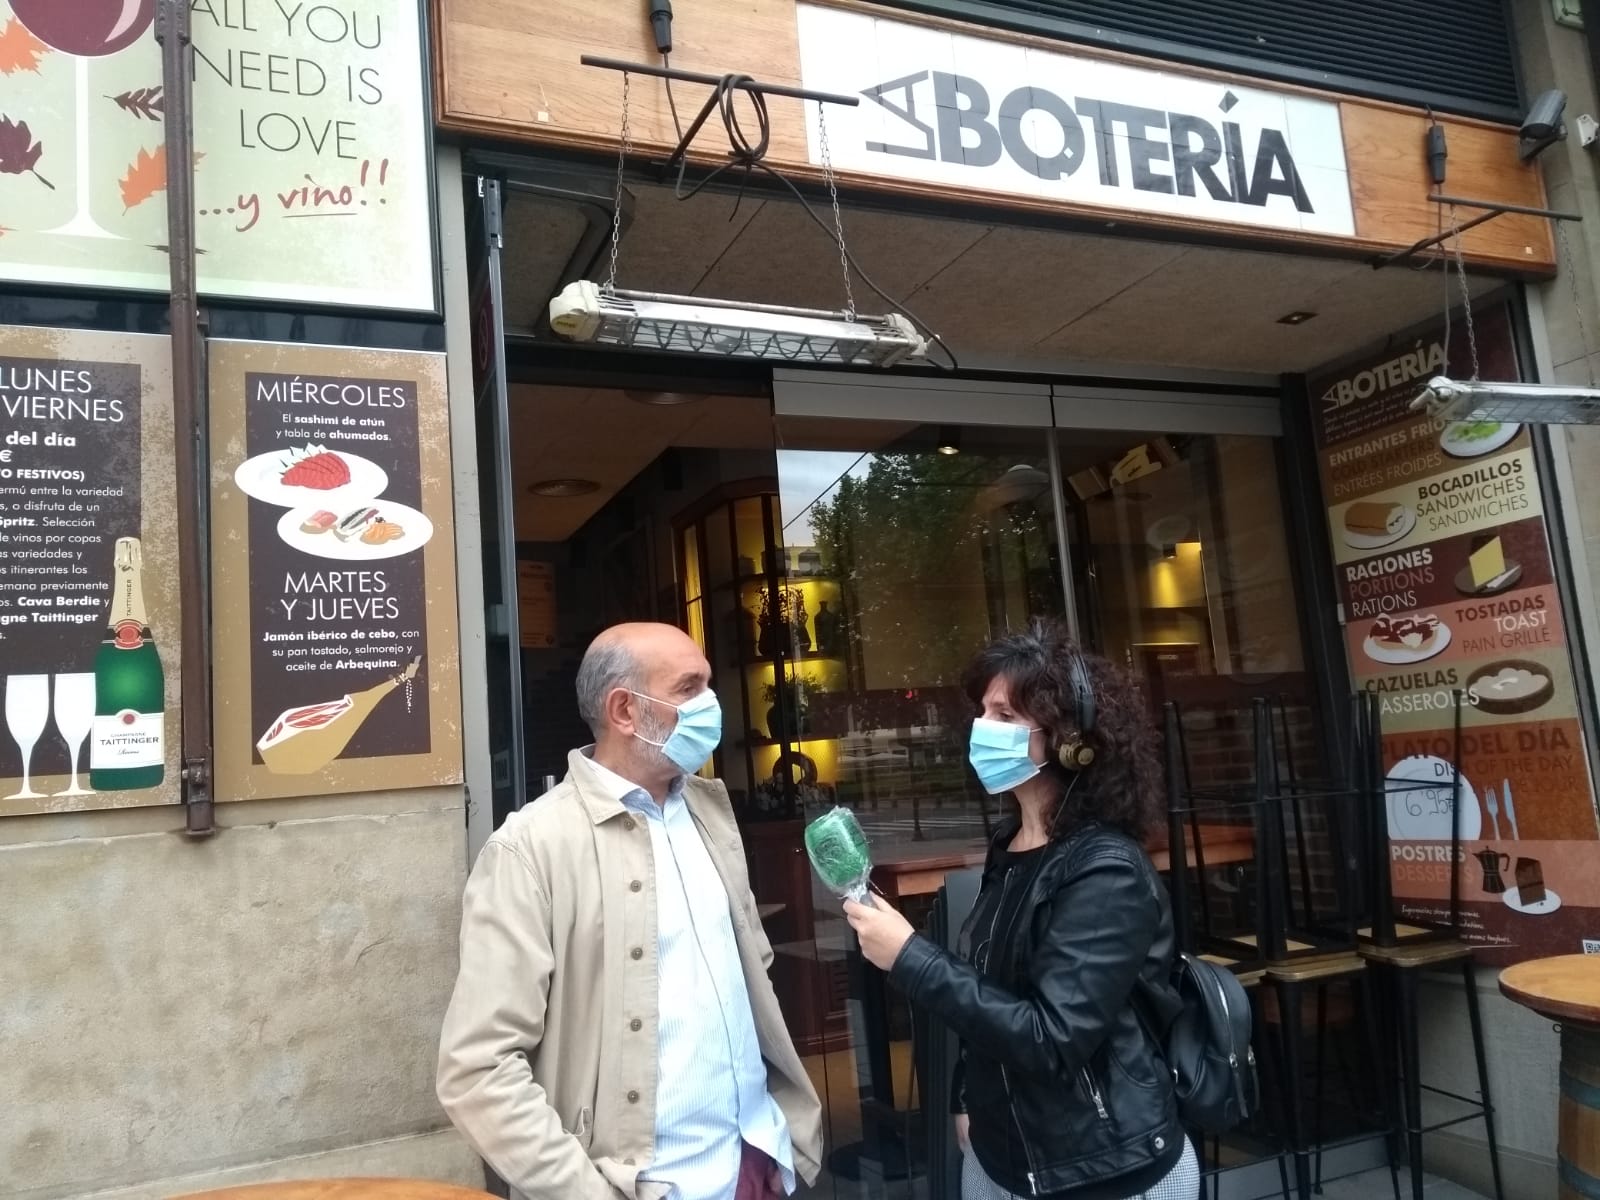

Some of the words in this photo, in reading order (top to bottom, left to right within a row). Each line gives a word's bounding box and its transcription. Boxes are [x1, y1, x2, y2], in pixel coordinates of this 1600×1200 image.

[191, 0, 258, 31] ALL
[275, 0, 382, 49] YOU
[191, 44, 326, 97] NEED
[347, 65, 383, 105] IS
[240, 108, 358, 160] LOVE
[932, 70, 1316, 214] BOTERÍA
[0, 367, 92, 394] LUNES
[1337, 340, 1450, 407] BOTERÍA
[256, 376, 406, 409] MIÉRCOLES
[2, 395, 124, 422] VIERNES
[282, 414, 292, 423] El
[294, 415, 338, 426] sashimi
[342, 416, 356, 426] de
[359, 416, 386, 427] atún
[5, 430, 37, 445] del
[44, 432, 76, 447] día
[275, 430, 282, 440] y
[284, 428, 311, 439] tabla
[313, 429, 326, 439] de
[329, 430, 392, 441] ahumados.
[1329, 430, 1408, 467] ENTRANTES
[17, 468, 85, 482] FESTIVOS)
[1333, 469, 1384, 497] ENTRÉES
[1387, 451, 1442, 481] FROIDES
[1418, 458, 1522, 499] BOCADILLOS
[30, 487, 58, 495] entre
[62, 485, 72, 496] la
[76, 486, 124, 497] variedad
[1416, 476, 1525, 517] SANDWICHES
[23, 500, 65, 511] disfruta
[68, 501, 83, 511] de
[1429, 494, 1529, 532] SANDWICHES
[42, 517, 95, 527] Selección
[12, 533, 42, 542] vinos
[45, 535, 65, 544] por
[68, 535, 101, 544] copas
[11, 548, 73, 558] variedades
[77, 551, 83, 560] y
[1346, 548, 1433, 582] RACIONES
[10, 564, 68, 574] itinerantes
[72, 564, 88, 574] los
[40, 580, 109, 592] previamente
[284, 571, 387, 593] MARTES
[1350, 567, 1435, 599] PORTIONS
[17, 597, 52, 607] Cava
[56, 595, 100, 607] Berdie
[104, 598, 110, 608] y
[280, 598, 298, 621] Y
[306, 597, 399, 621] JUEVES
[1352, 590, 1417, 617] RATIONS
[1456, 594, 1545, 622] TOSTADAS
[31, 612, 99, 624] Taittinger
[1494, 609, 1548, 633] TOAST
[263, 631, 304, 642] Jamón
[307, 629, 348, 641] ibérico
[350, 629, 365, 640] de
[368, 629, 398, 640] cebo,
[401, 630, 420, 638] con
[1463, 636, 1496, 654] PAIN
[1501, 628, 1550, 649] GRILLE
[287, 648, 307, 658] pan
[311, 646, 351, 657] tostado,
[354, 644, 404, 656] salmorejo
[407, 645, 413, 654] y
[286, 661, 316, 671] aceite
[319, 660, 333, 670] de
[335, 659, 400, 671] Arbequina.
[1365, 668, 1458, 694] CAZUELAS
[1380, 688, 1480, 715] ASSEROLES
[100, 736, 159, 746] TAITTINGER
[1384, 735, 1452, 761] LATO
[1463, 731, 1508, 756] DEL
[1476, 759, 1497, 774] OF
[1503, 758, 1533, 774] THE
[1538, 754, 1574, 771] DAY
